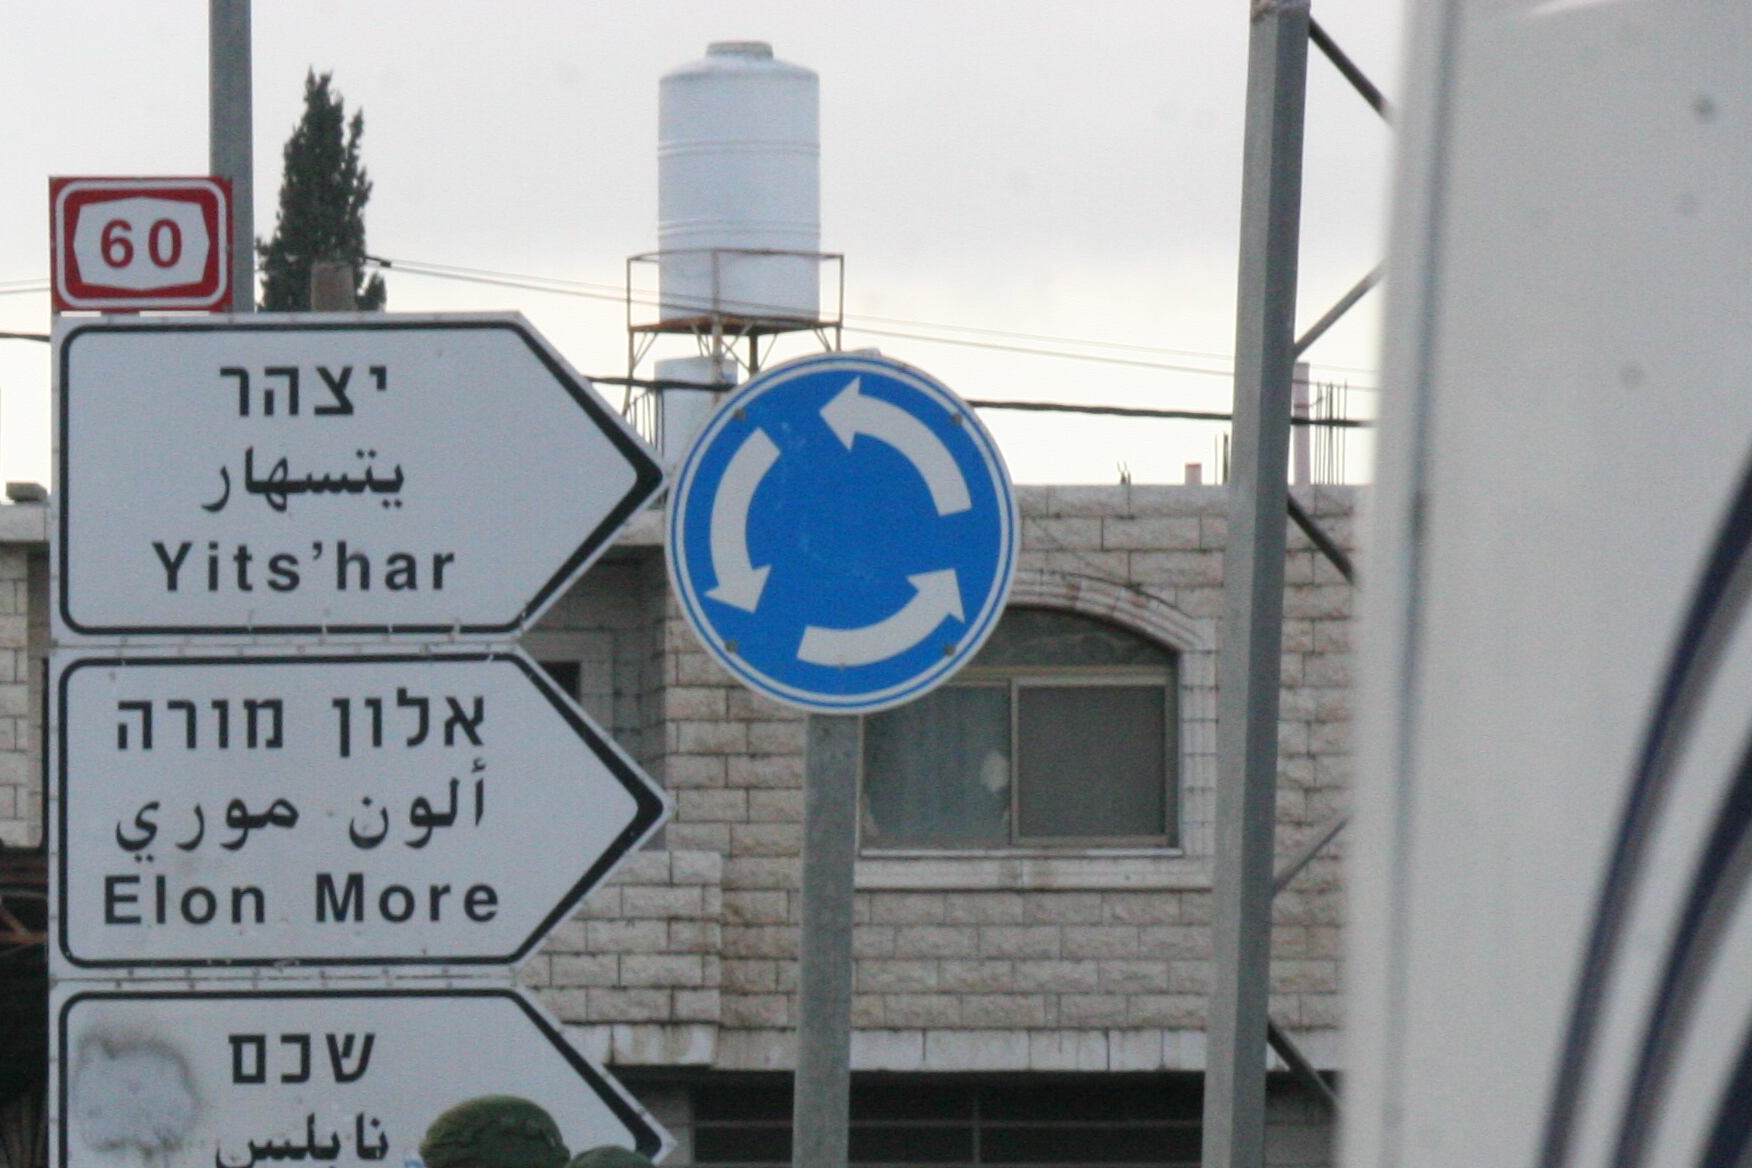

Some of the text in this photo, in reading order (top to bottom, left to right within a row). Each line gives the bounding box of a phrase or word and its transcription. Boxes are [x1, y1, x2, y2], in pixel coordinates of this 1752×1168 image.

[101, 219, 182, 269] 60
[220, 366, 386, 416] יצהר
[203, 448, 404, 513] يتسهار
[153, 541, 454, 592] Yits'har
[118, 688, 484, 757] אלון מורה
[116, 757, 485, 862] ألون موري
[105, 873, 498, 925] Elon More
[229, 1034, 375, 1084] שכם
